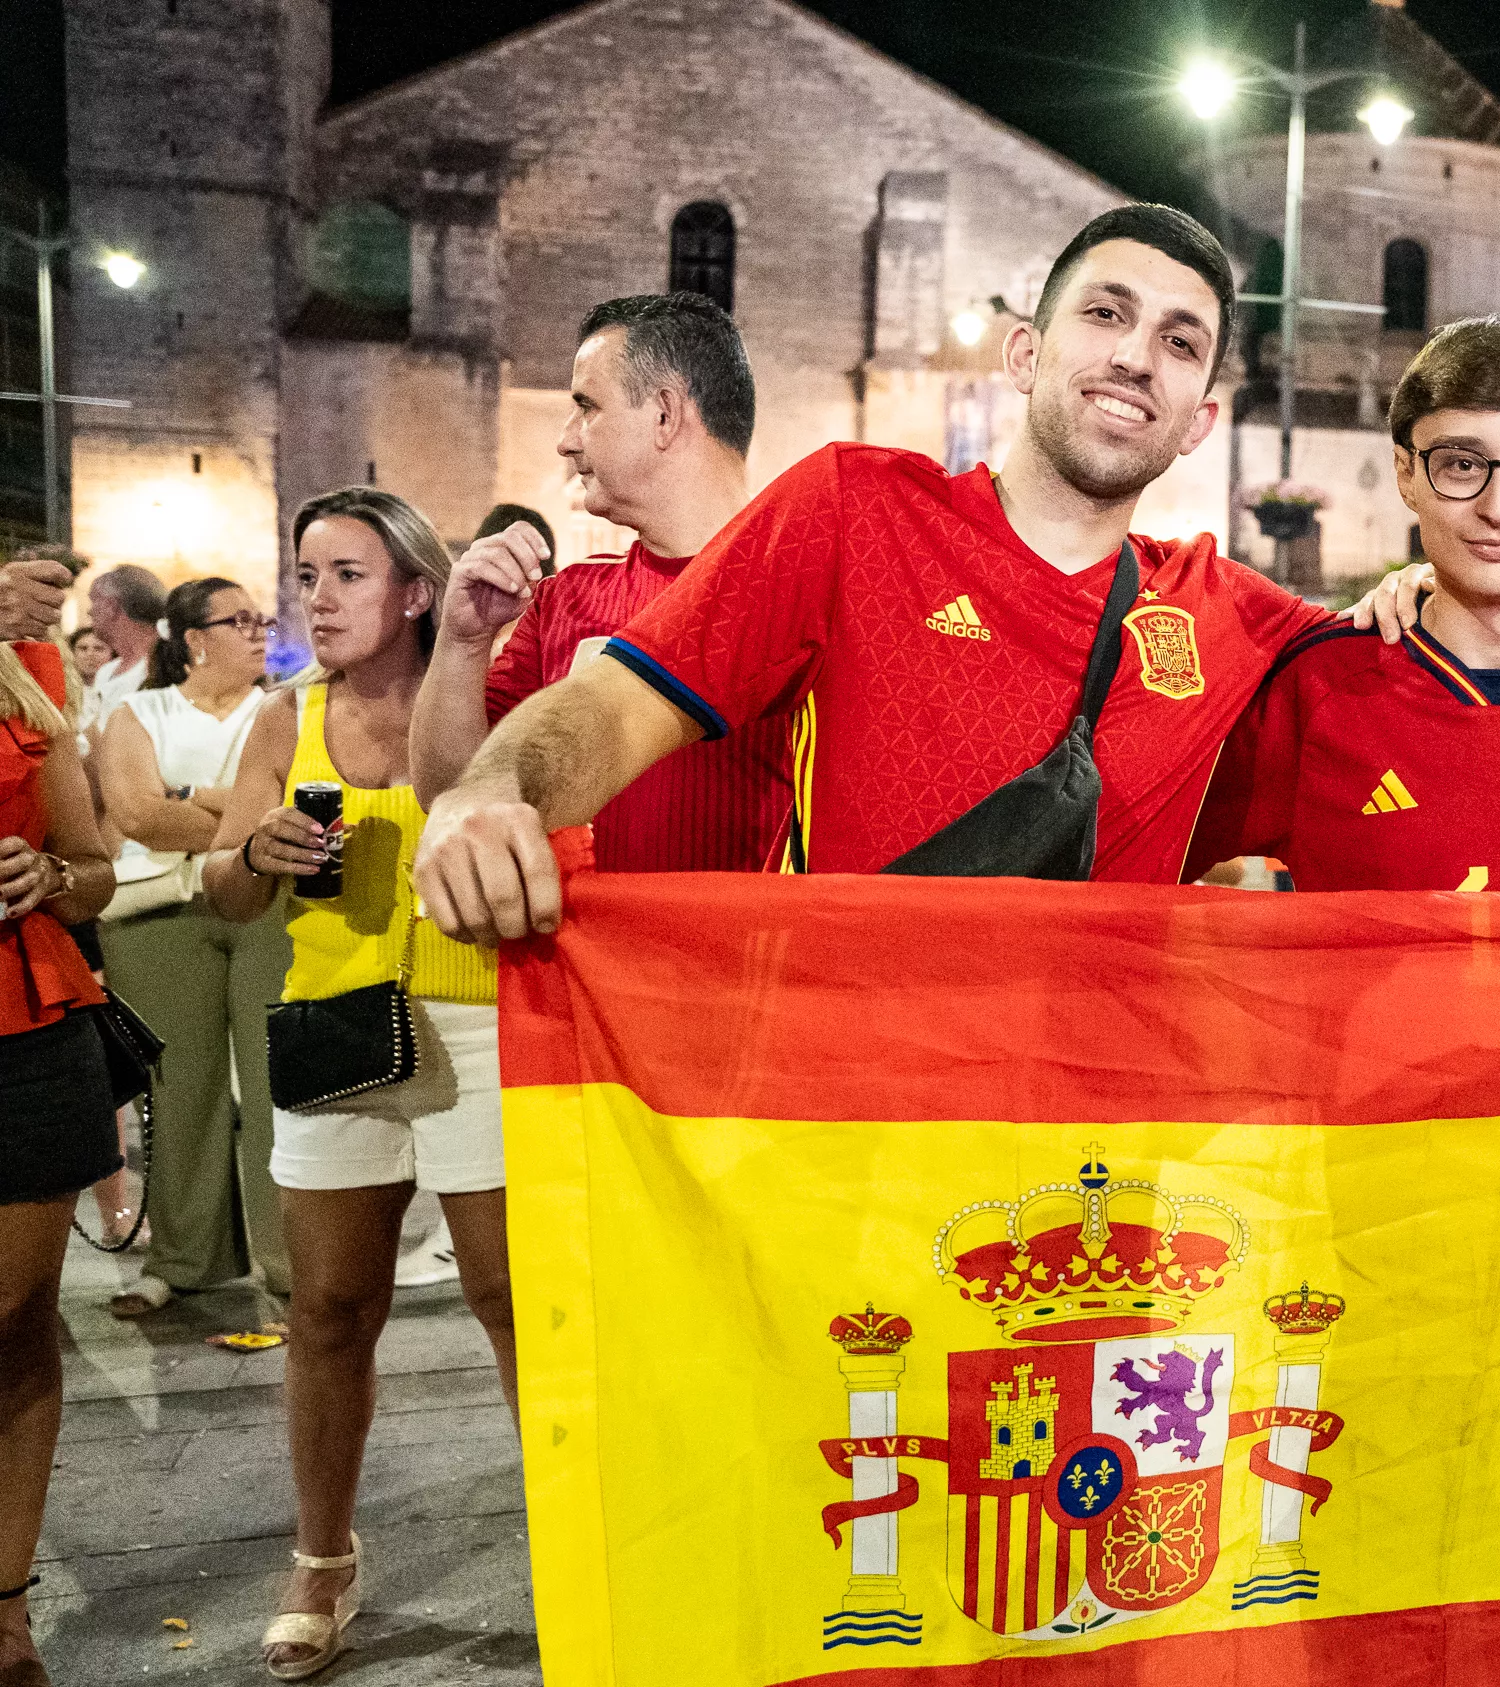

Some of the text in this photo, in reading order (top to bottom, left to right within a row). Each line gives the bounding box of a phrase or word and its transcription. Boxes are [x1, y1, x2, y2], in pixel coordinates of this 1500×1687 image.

[925, 617, 992, 642] adidas
[1252, 1410, 1333, 1433] VLTRA
[840, 1437, 921, 1456] PLVS
